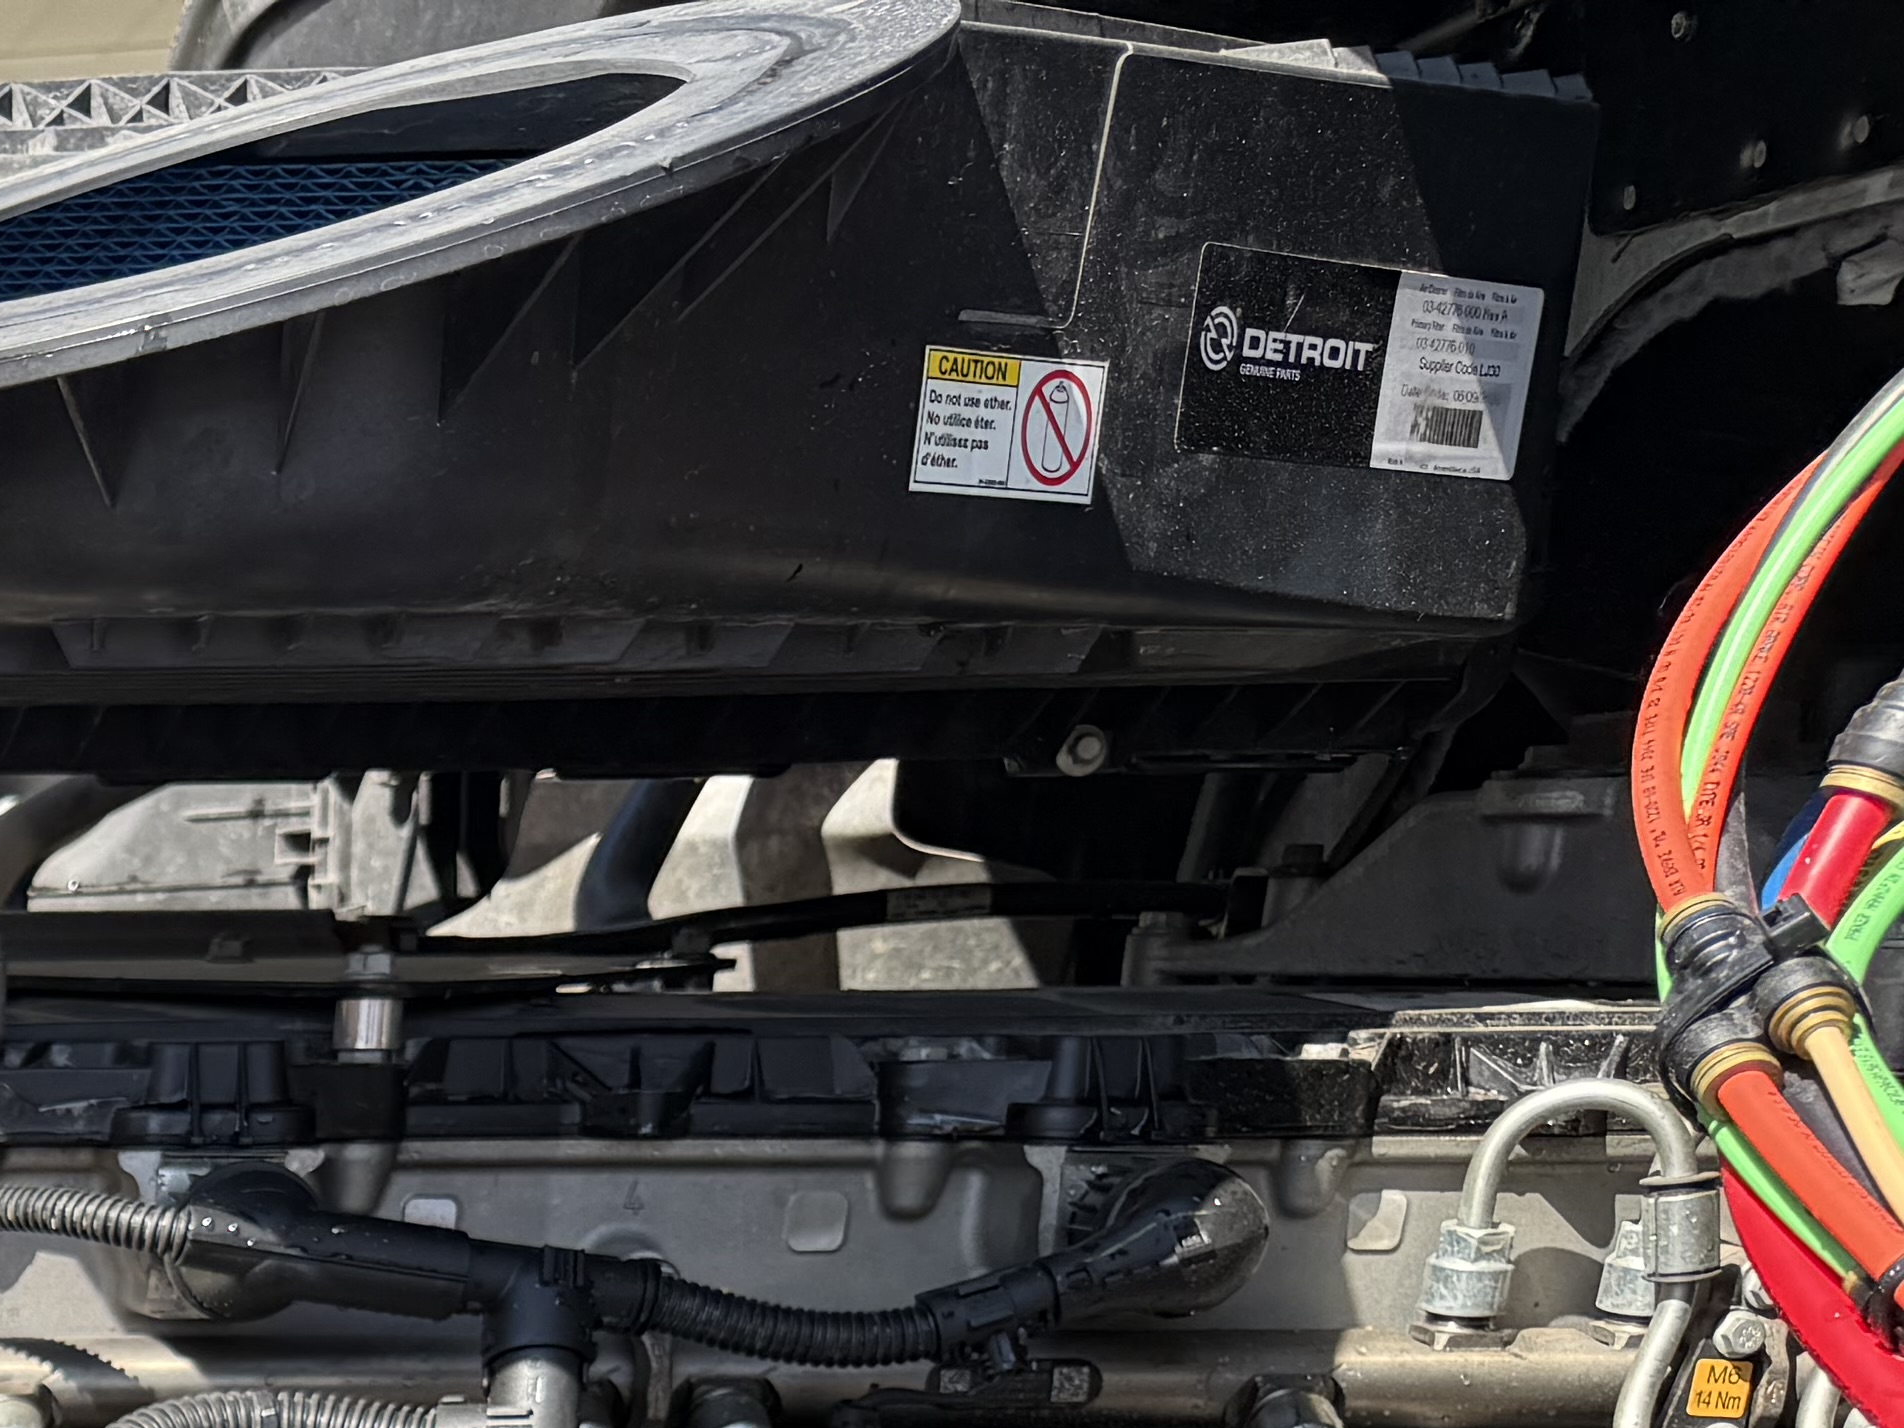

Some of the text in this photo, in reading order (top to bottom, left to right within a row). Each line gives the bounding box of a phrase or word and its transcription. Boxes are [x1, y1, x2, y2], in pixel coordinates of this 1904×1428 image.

[1242, 327, 1375, 371] DETROIT
[938, 355, 1008, 382] CAUTION
[1239, 363, 1301, 381] GENUINE PARTS
[1419, 357, 1453, 375] Supplier
[929, 389, 1012, 411] Do not use ether.
[926, 411, 940, 426] No
[943, 413, 972, 428] utilice
[970, 439, 989, 452] pas
[1707, 1365, 1742, 1384] M6
[1696, 1390, 1741, 1409] 14 Nm
